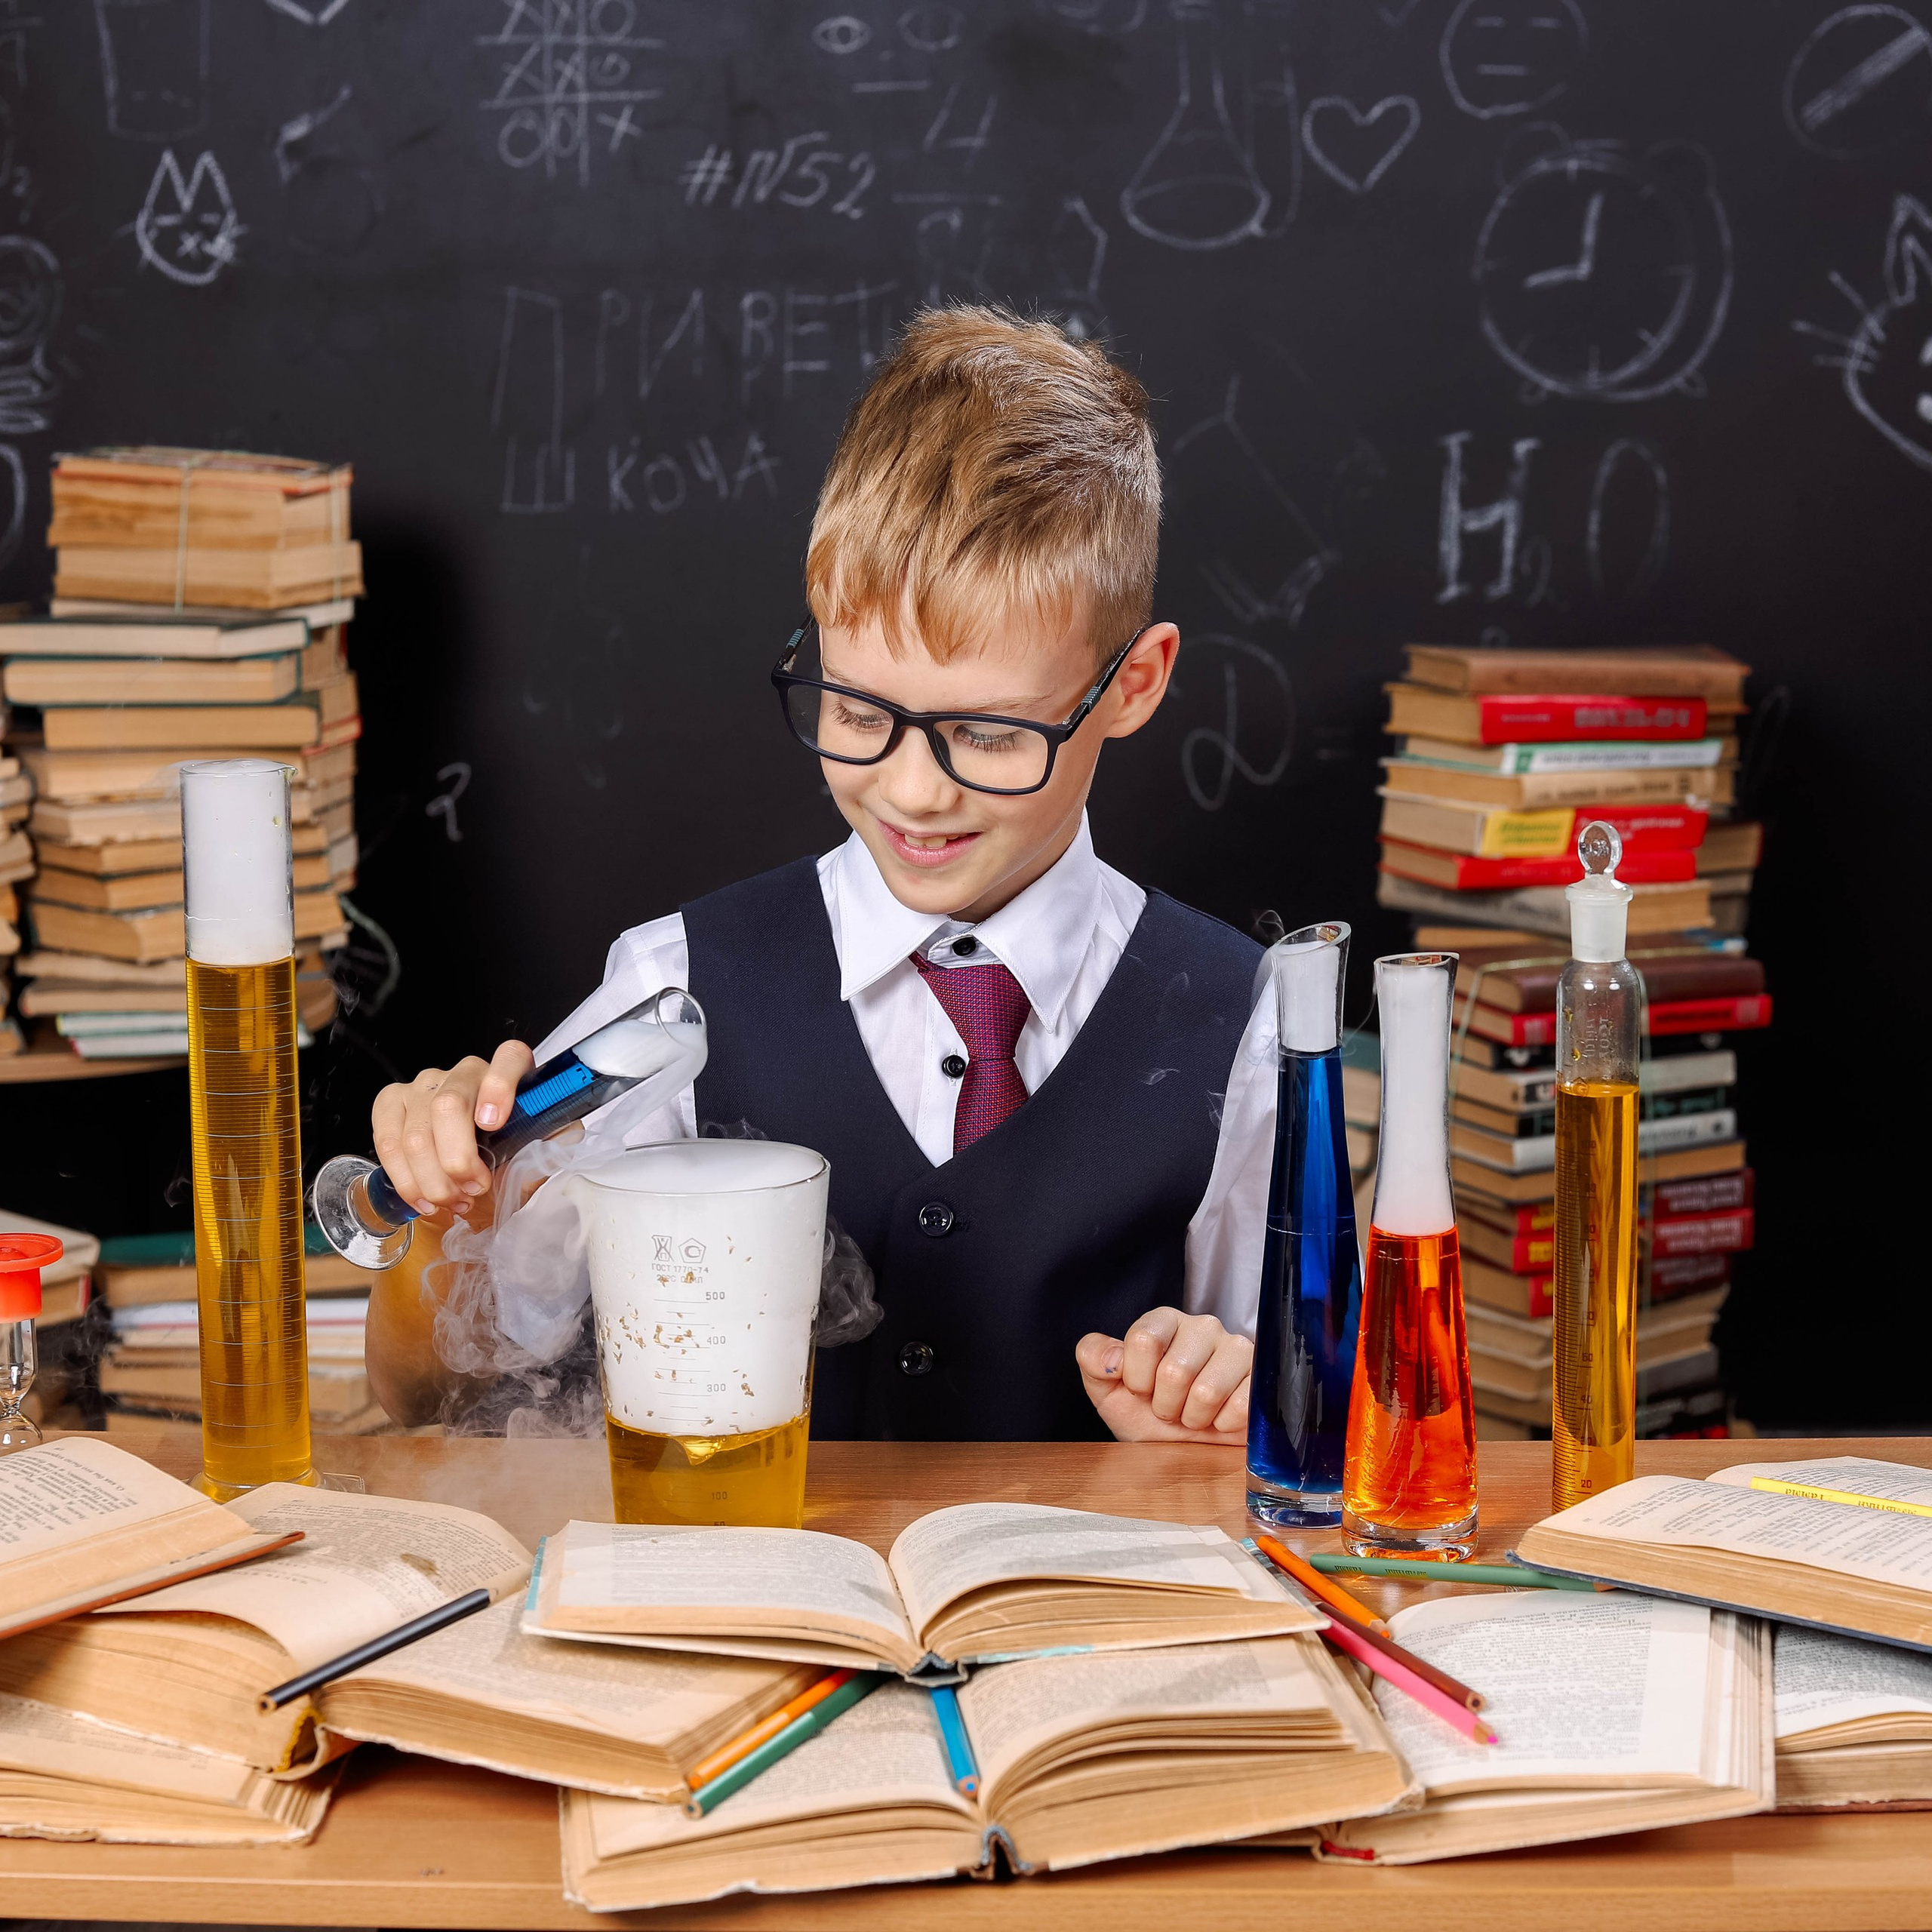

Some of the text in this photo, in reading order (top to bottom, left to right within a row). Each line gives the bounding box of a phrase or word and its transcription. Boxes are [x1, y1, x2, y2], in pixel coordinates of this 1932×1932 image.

[651, 1263, 671, 1272] ГОСТ
[706, 1292, 725, 1300] 500
[706, 1336, 726, 1345] 400
[1582, 1353, 1593, 1361] 50
[706, 1383, 727, 1392] 300
[1580, 1479, 1592, 1488] 20
[712, 1491, 728, 1500] 100
